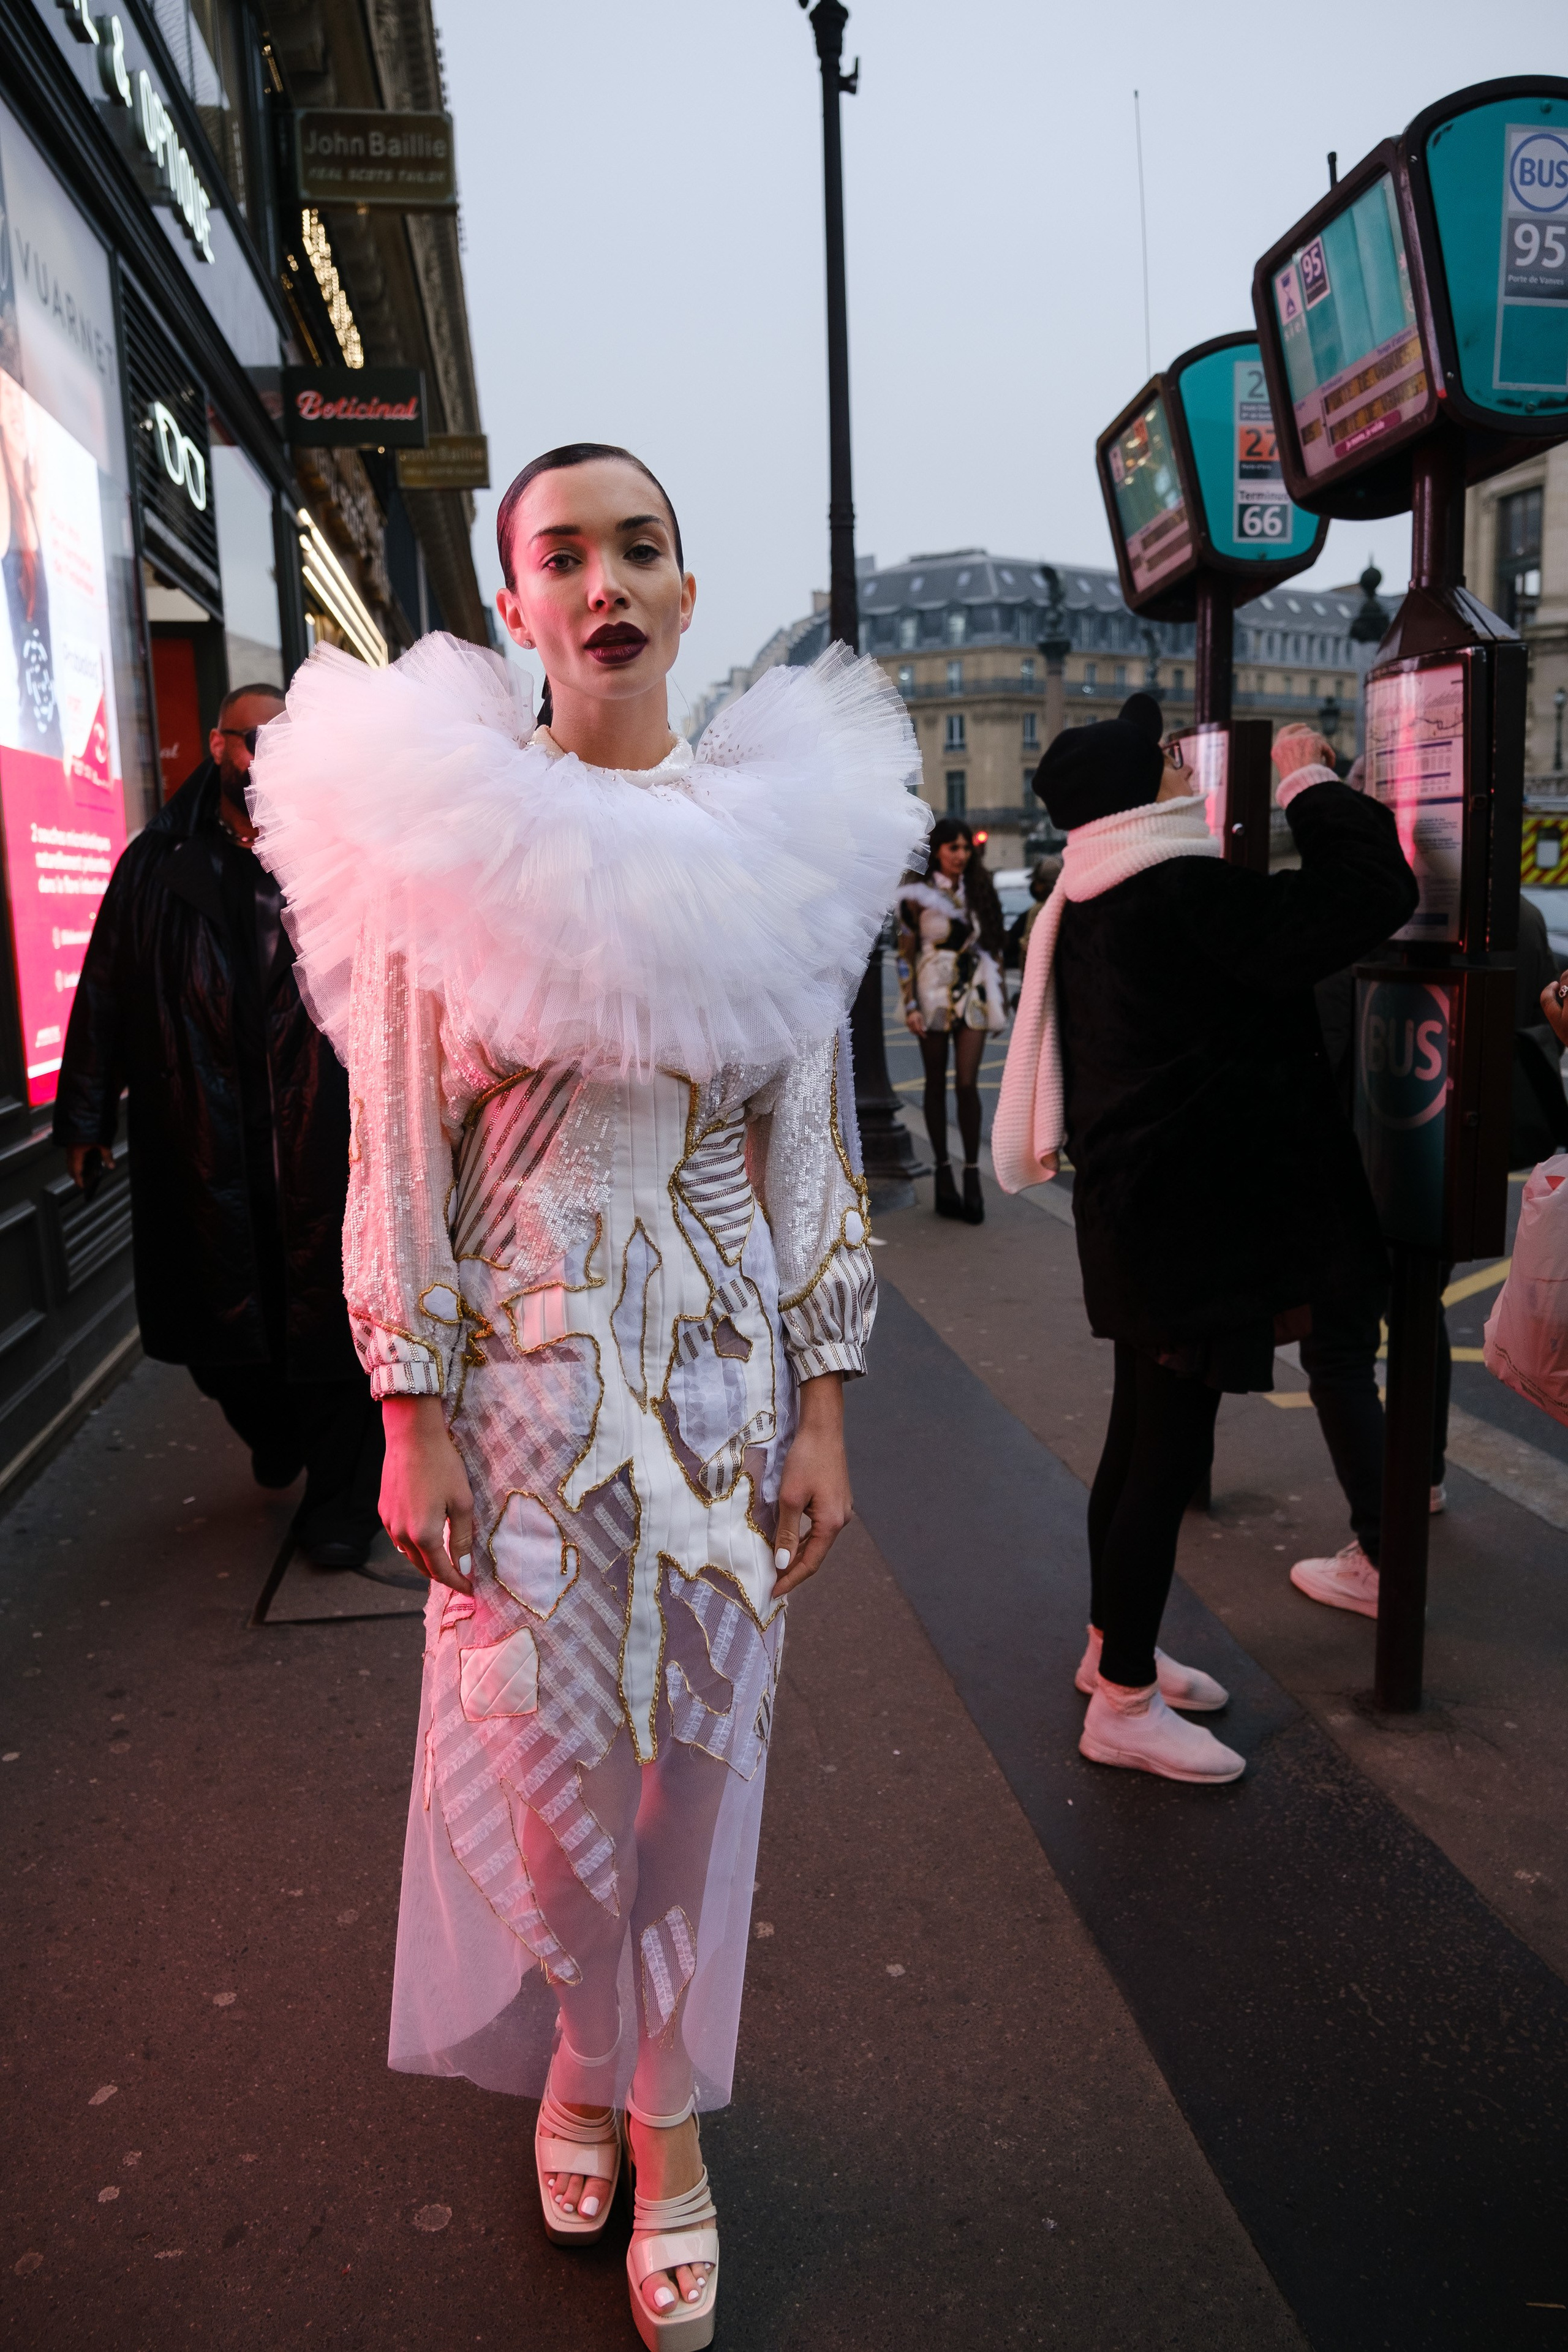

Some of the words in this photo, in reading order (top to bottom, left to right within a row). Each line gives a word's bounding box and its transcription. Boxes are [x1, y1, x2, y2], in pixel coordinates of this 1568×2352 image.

[304, 130, 366, 155] John
[368, 130, 447, 157] Baillie
[1519, 157, 1568, 189] BUS
[1514, 223, 1566, 268] 95
[1302, 246, 1322, 284] 95
[1507, 274, 1528, 283] Porte
[1528, 274, 1539, 284] de
[15, 226, 115, 384] VUARNET
[1248, 371, 1265, 399] 2
[296, 390, 418, 420] Boticinal
[1245, 429, 1277, 457] 27
[1243, 505, 1283, 537] 66
[1366, 1014, 1442, 1082] BUS
